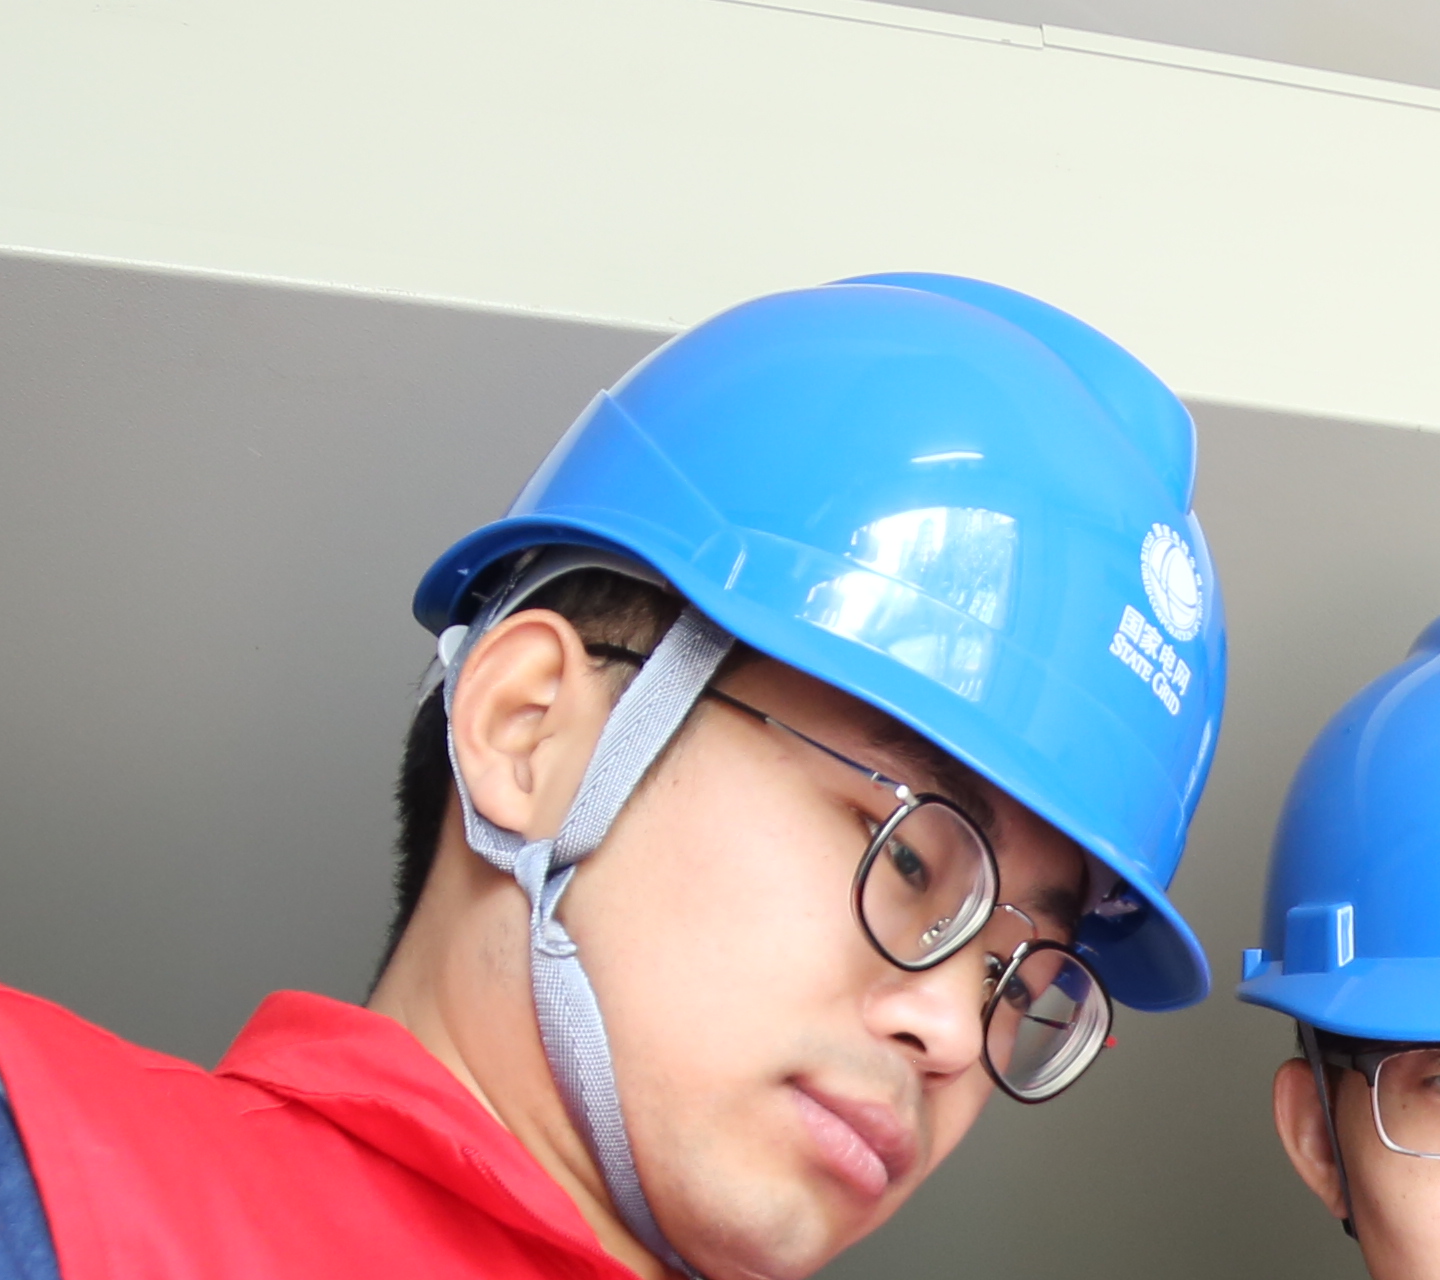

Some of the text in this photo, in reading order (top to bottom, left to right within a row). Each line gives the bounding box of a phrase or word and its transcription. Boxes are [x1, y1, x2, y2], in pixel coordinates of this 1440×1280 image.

[1110, 632, 1180, 715] STATE GRID
[1119, 604, 1191, 696] 国家电网
